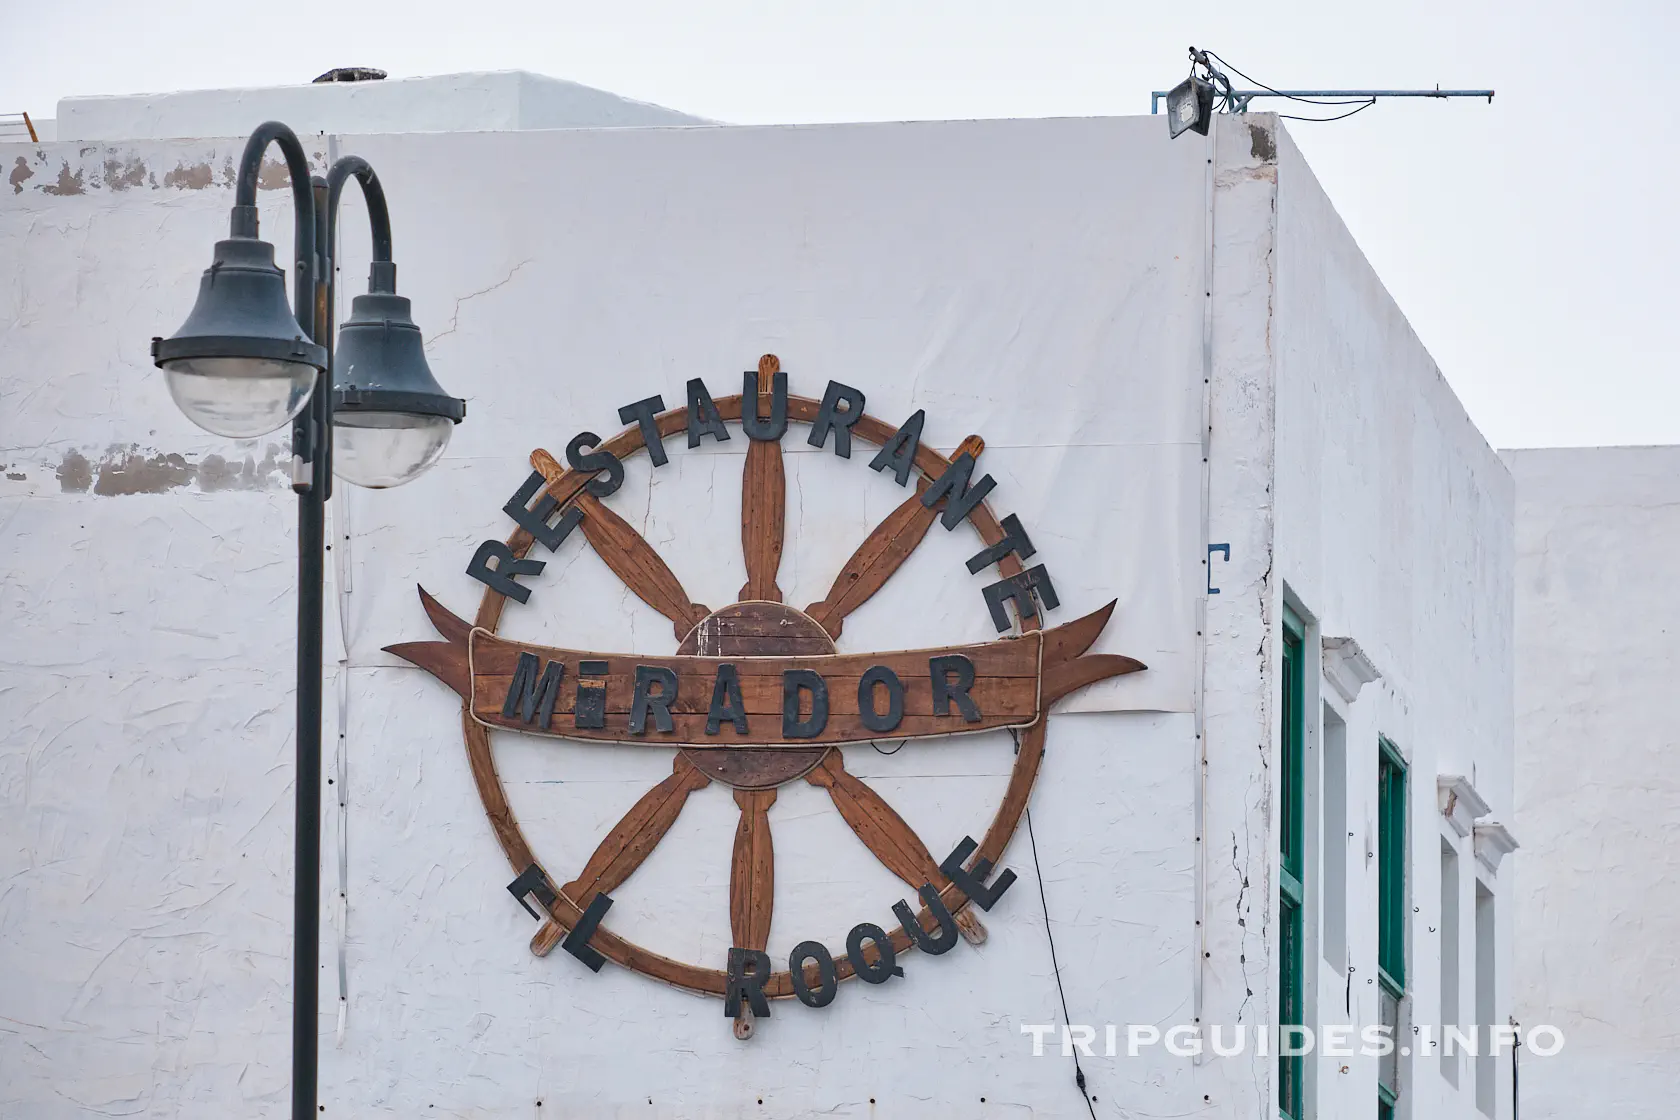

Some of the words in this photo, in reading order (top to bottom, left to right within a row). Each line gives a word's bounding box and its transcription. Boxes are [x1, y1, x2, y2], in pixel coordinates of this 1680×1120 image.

[466, 371, 1060, 633] RESTAURANTE
[503, 652, 981, 739] MIRADOR
[724, 836, 1017, 1018] ROQUE
